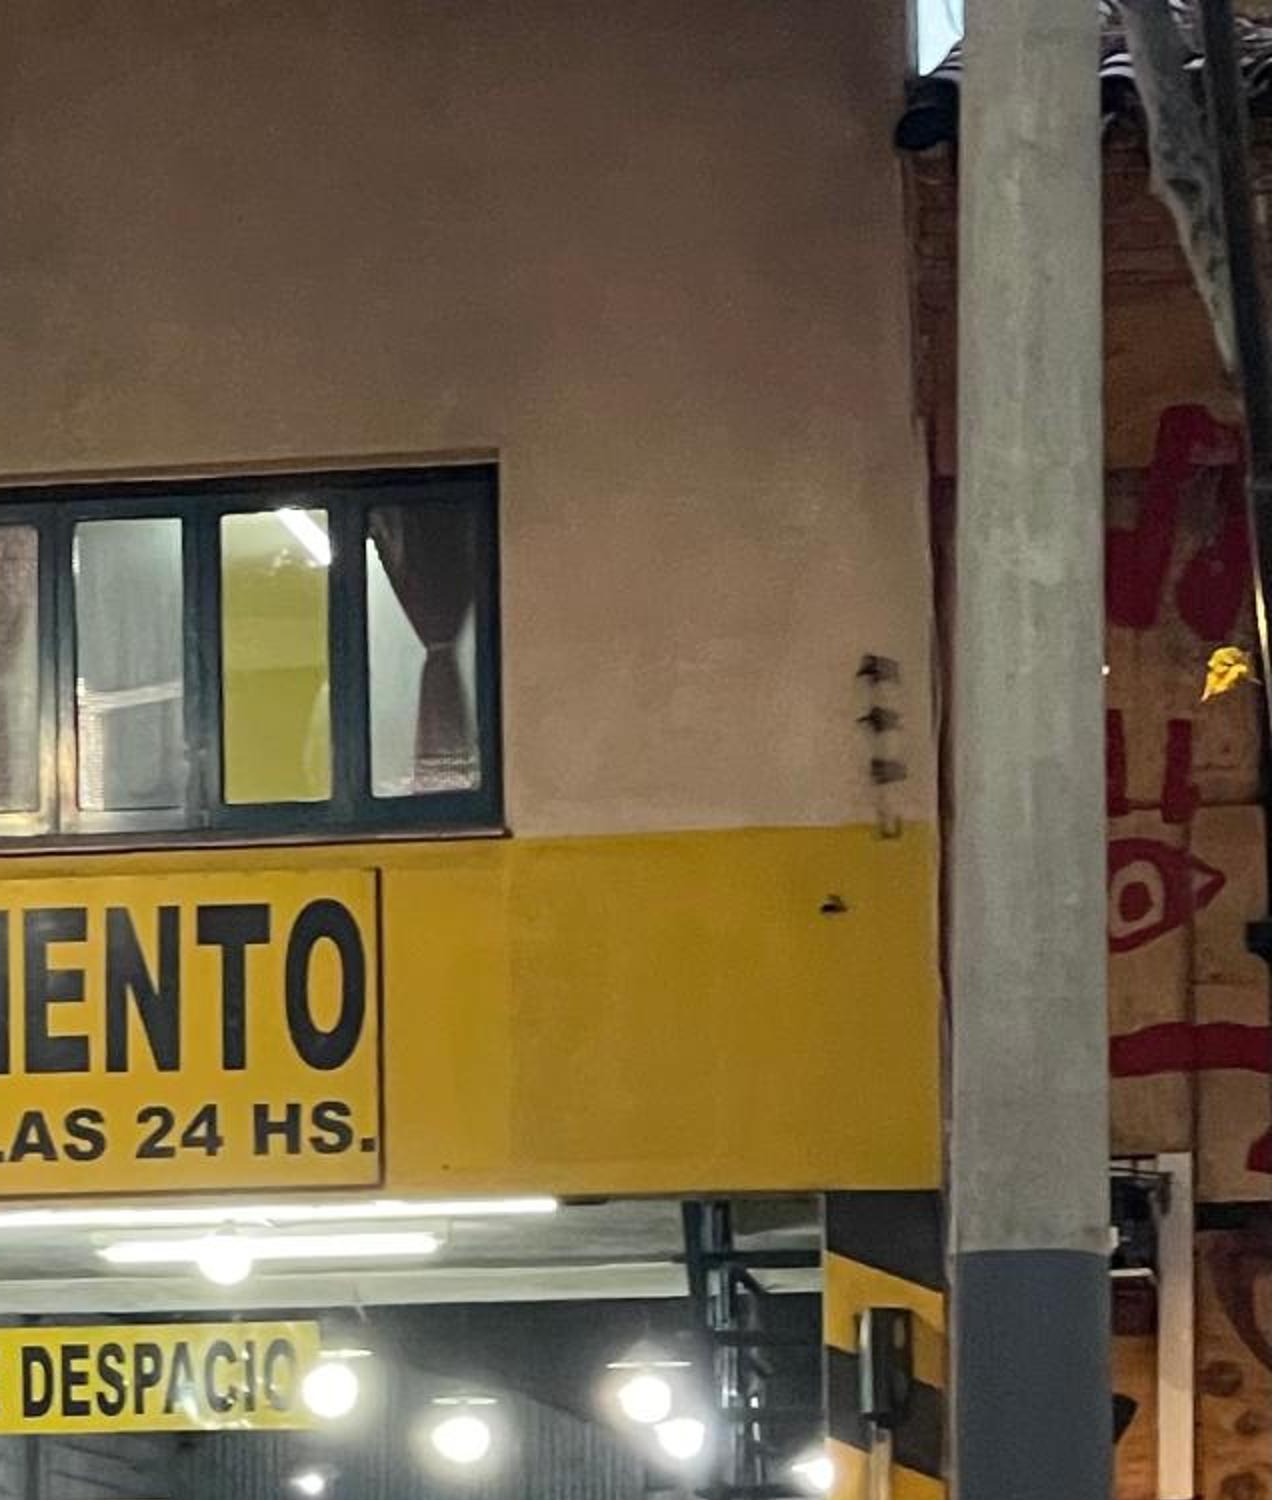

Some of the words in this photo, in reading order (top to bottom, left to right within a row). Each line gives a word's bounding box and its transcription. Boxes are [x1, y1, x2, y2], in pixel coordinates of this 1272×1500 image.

[135, 1103, 222, 1158] 24
[253, 1100, 376, 1156] HS.
[22, 1338, 298, 1418] DESPACIO
